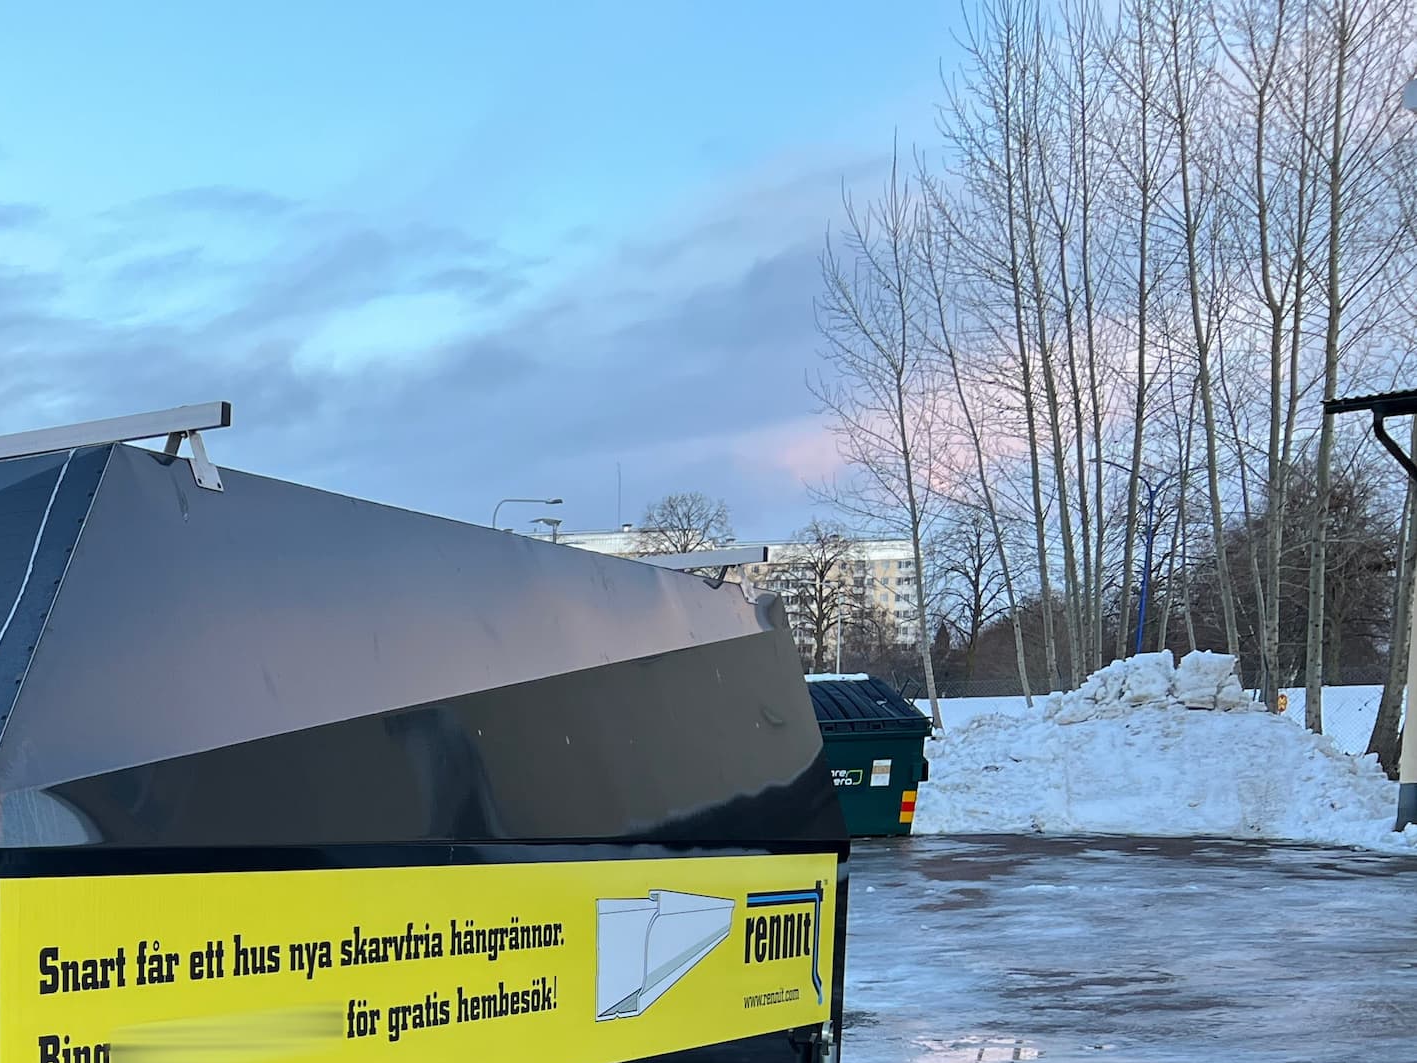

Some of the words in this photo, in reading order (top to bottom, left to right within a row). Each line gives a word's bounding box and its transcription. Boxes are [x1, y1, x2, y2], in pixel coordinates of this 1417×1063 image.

[39, 947, 126, 995] Snart
[136, 940, 180, 986] får
[189, 940, 224, 981] ett
[233, 934, 281, 977] hus
[289, 940, 333, 980] nya
[340, 922, 444, 967] skarvfria
[449, 916, 565, 962] hängrännor.
[744, 912, 811, 964] rennit
[346, 999, 380, 1039] för
[387, 991, 450, 1042] gratis
[456, 975, 558, 1024] hembesök!
[743, 988, 800, 1009] www.rennit.com
